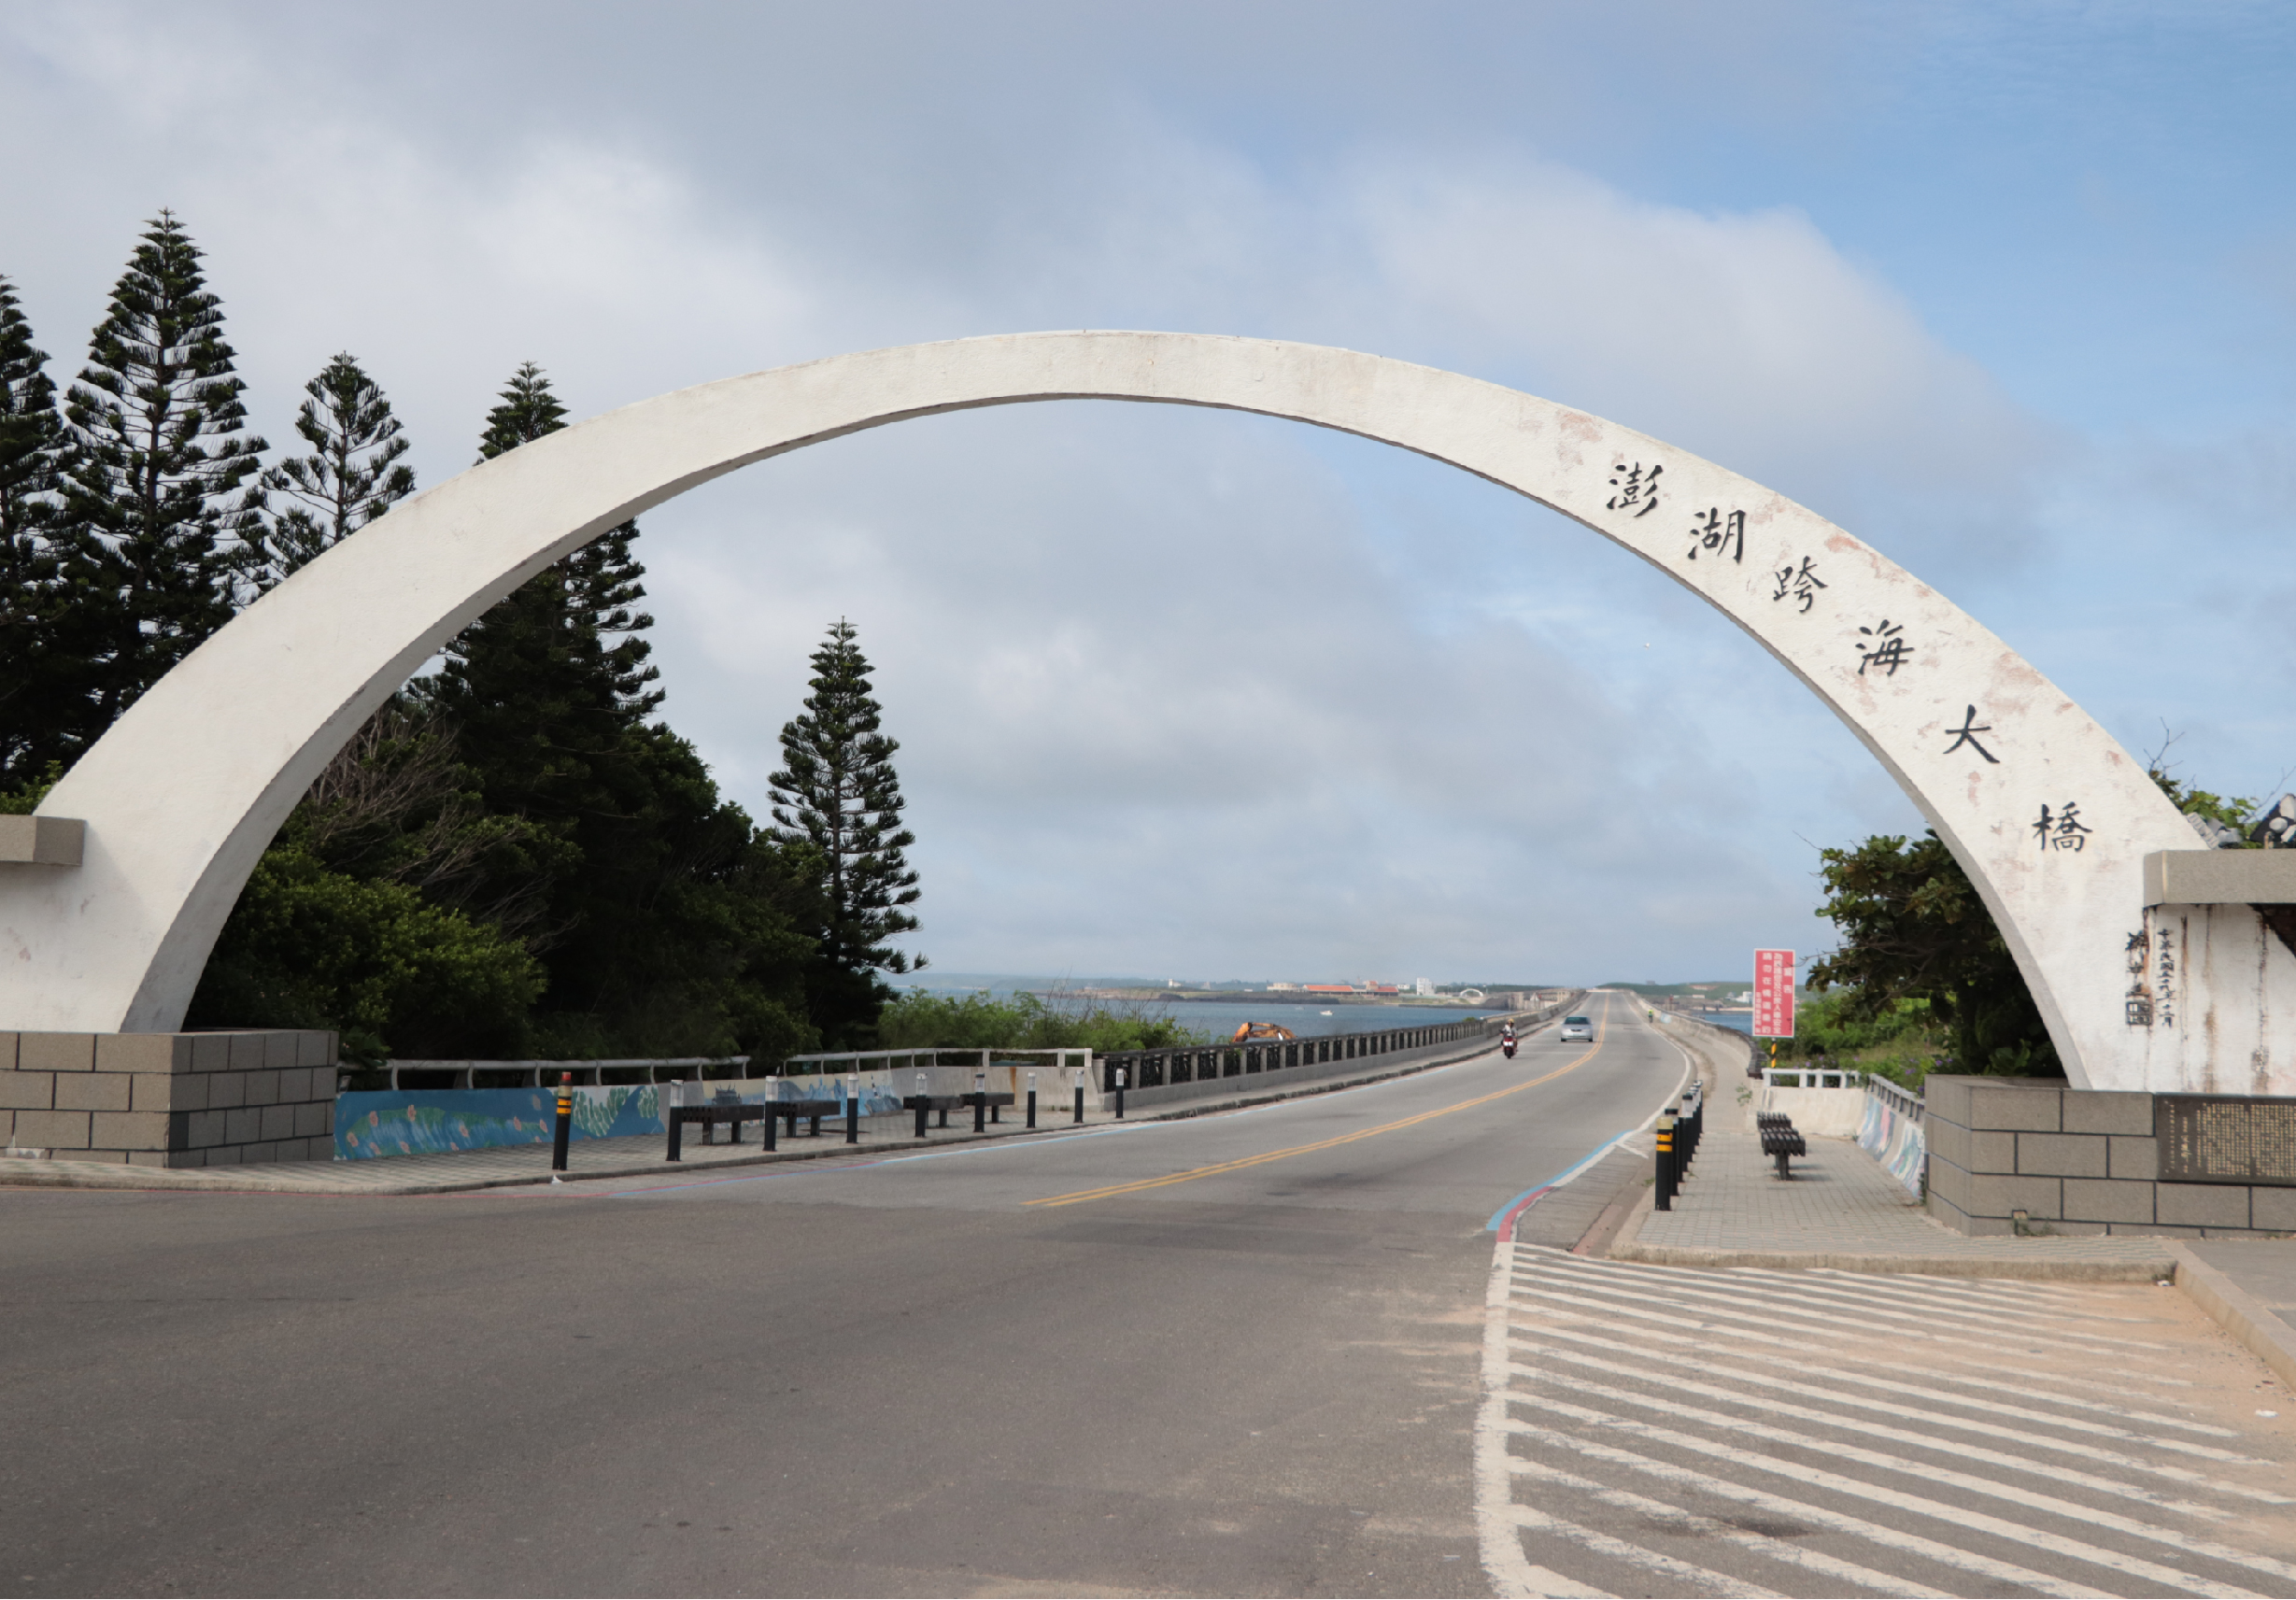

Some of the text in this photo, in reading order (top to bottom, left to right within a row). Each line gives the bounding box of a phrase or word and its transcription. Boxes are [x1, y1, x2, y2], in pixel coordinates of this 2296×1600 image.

[1606, 461, 2092, 853] 澎湖跨海大橋
